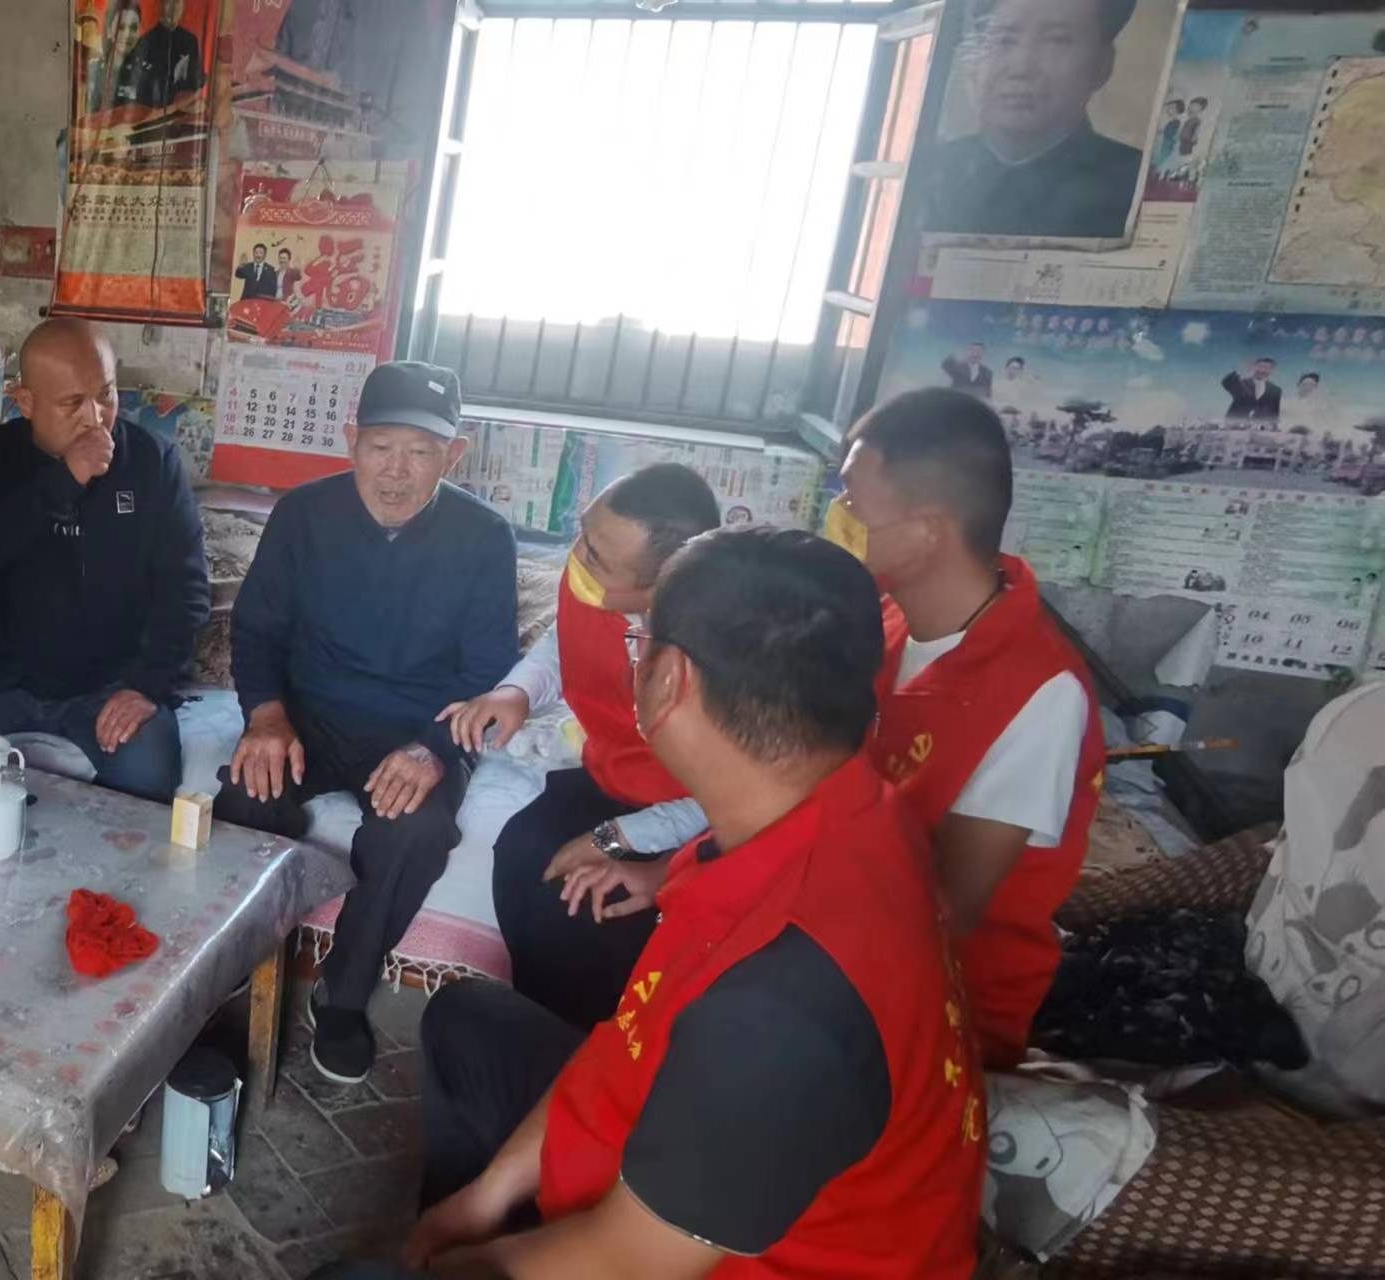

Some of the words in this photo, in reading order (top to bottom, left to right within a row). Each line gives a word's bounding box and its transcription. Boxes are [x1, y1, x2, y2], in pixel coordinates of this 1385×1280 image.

[301, 235, 371, 311] 福
[250, 389, 257, 398] 5
[269, 392, 276, 400] 6
[290, 393, 296, 401] 7
[309, 395, 315, 405] 8
[329, 398, 336, 408] 9
[331, 385, 338, 394] 2
[247, 403, 257, 411] 12
[266, 405, 277, 413] 13
[286, 407, 296, 416] 14
[305, 409, 316, 418] 15
[326, 411, 336, 420] 16
[245, 415, 256, 424] 19
[264, 417, 275, 426] 20
[284, 419, 295, 429] 21
[303, 421, 315, 431] 22
[323, 424, 335, 433] 23
[223, 425, 234, 435] 25
[243, 428, 254, 437] 26
[263, 429, 274, 439] 27
[281, 432, 293, 442] 28
[301, 435, 313, 445] 29
[321, 437, 333, 447] 30
[1248, 610, 1270, 620] 04
[1290, 614, 1311, 624] 05
[1336, 618, 1360, 630] 06
[1241, 633, 1263, 644] 10
[1284, 638, 1303, 649] 11
[1331, 644, 1352, 656] 12
